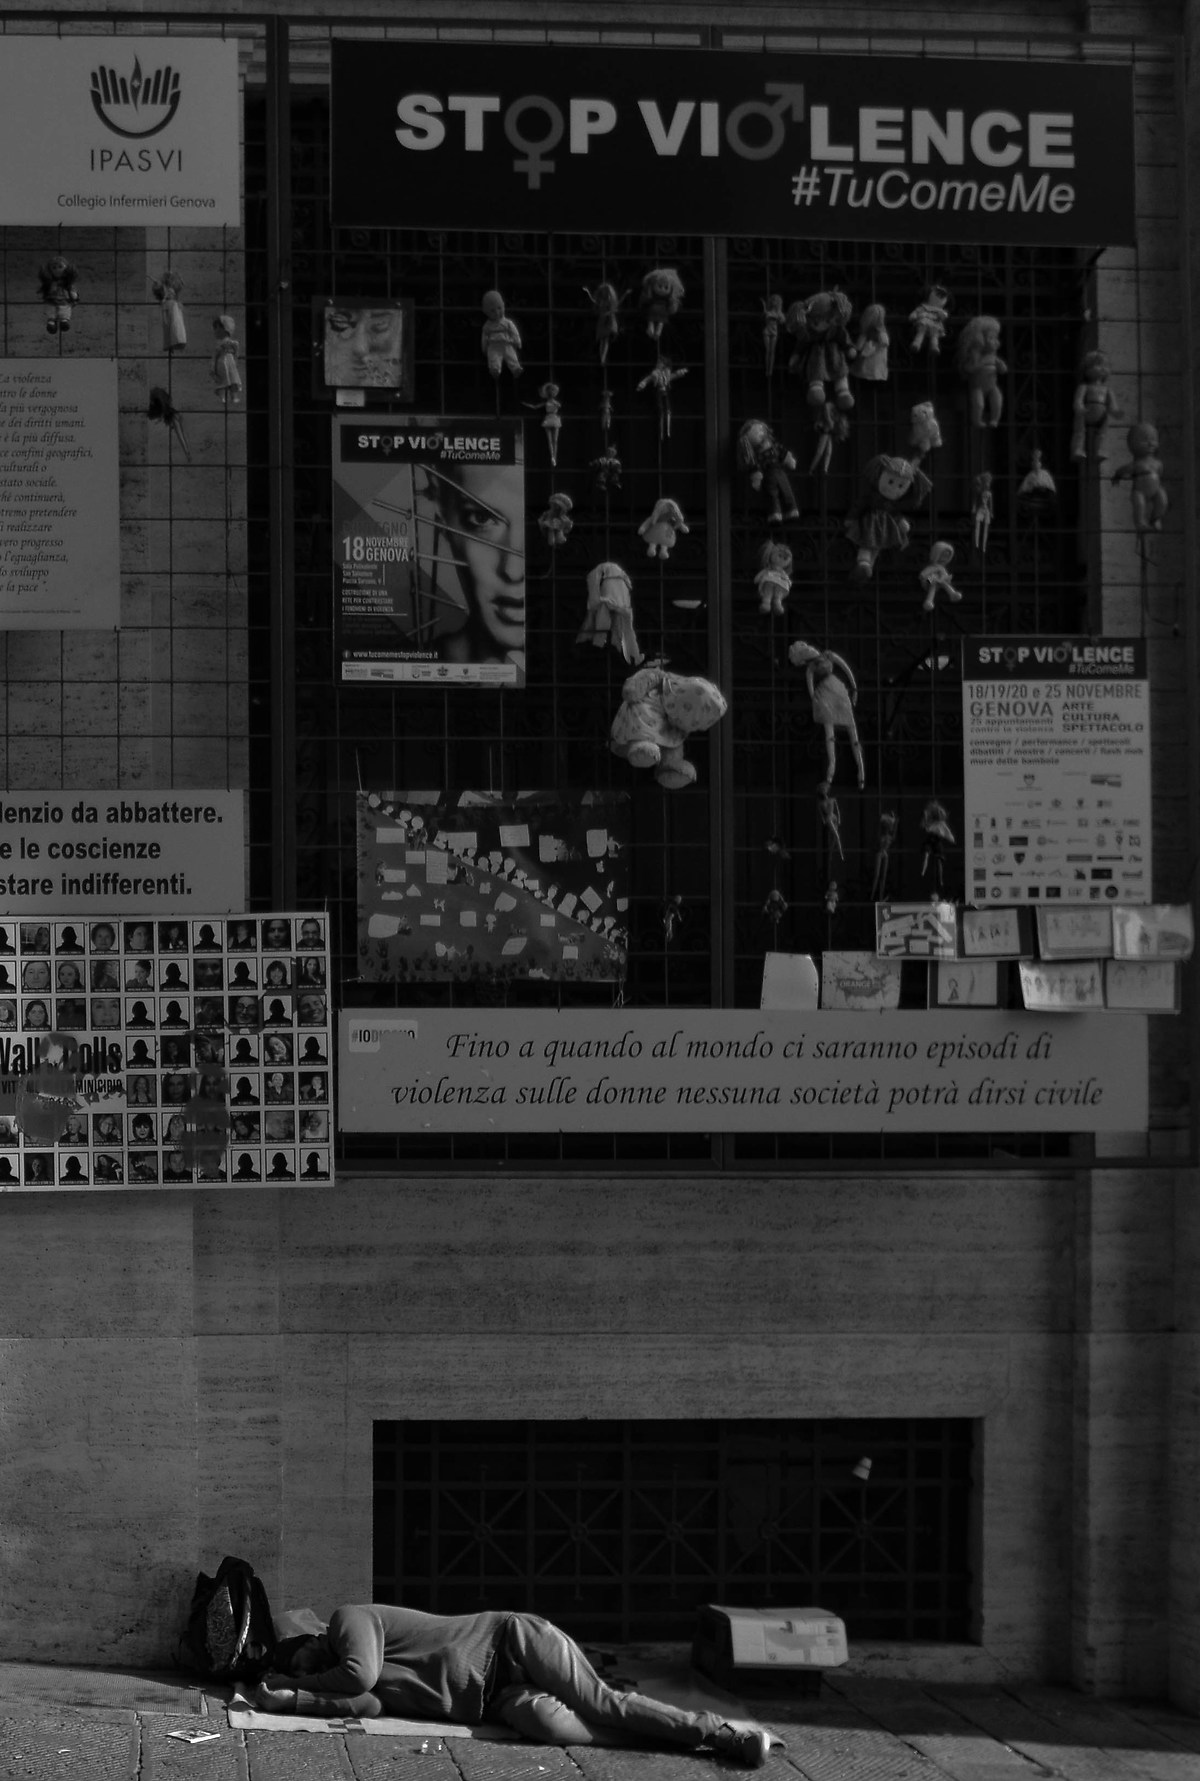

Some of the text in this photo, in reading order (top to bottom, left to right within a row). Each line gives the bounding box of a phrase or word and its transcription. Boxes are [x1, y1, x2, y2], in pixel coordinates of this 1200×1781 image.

[395, 82, 1075, 189] STOP VIOLENCE
[90, 149, 182, 172] IPASVI
[791, 166, 1075, 214] #TuComeMe
[57, 194, 216, 209] Collegio Infermieri Genova
[19, 387, 28, 398] le
[29, 387, 57, 399] donne
[440, 451, 501, 460] #TuComeMe
[29, 506, 78, 520] pretendere
[6, 520, 52, 532] realizzare
[0, 539, 19, 547] vero
[20, 539, 64, 550] progresso
[342, 536, 409, 561] 18 NOVEMBRE
[365, 548, 409, 562] GENOVA
[10, 565, 49, 580] sviluppo
[969, 684, 1142, 699] 18/19/20 e 25 NOVEMBRE
[970, 701, 1054, 717] GENOVA
[1062, 702, 1094, 711] ARTE
[1062, 712, 1120, 722] CULTURA
[1062, 723, 1144, 732] SPETTACOLO
[71, 801, 98, 824] da
[106, 801, 223, 824] abbattere.
[20, 837, 39, 860] le
[48, 837, 161, 860] coscienze
[61, 872, 192, 896] indifferenti.
[447, 1033, 510, 1059] Fino
[518, 1041, 535, 1058] a
[544, 1030, 643, 1064] quando
[652, 1030, 680, 1059] al
[687, 1031, 774, 1059] mondo
[783, 1033, 806, 1058] ci
[813, 1041, 918, 1059] saranno
[927, 1031, 1020, 1065] episodi
[1026, 1031, 1054, 1060] di
[391, 1076, 1104, 1112] violenza sulle donne nessuna società potrà dirsi civile
